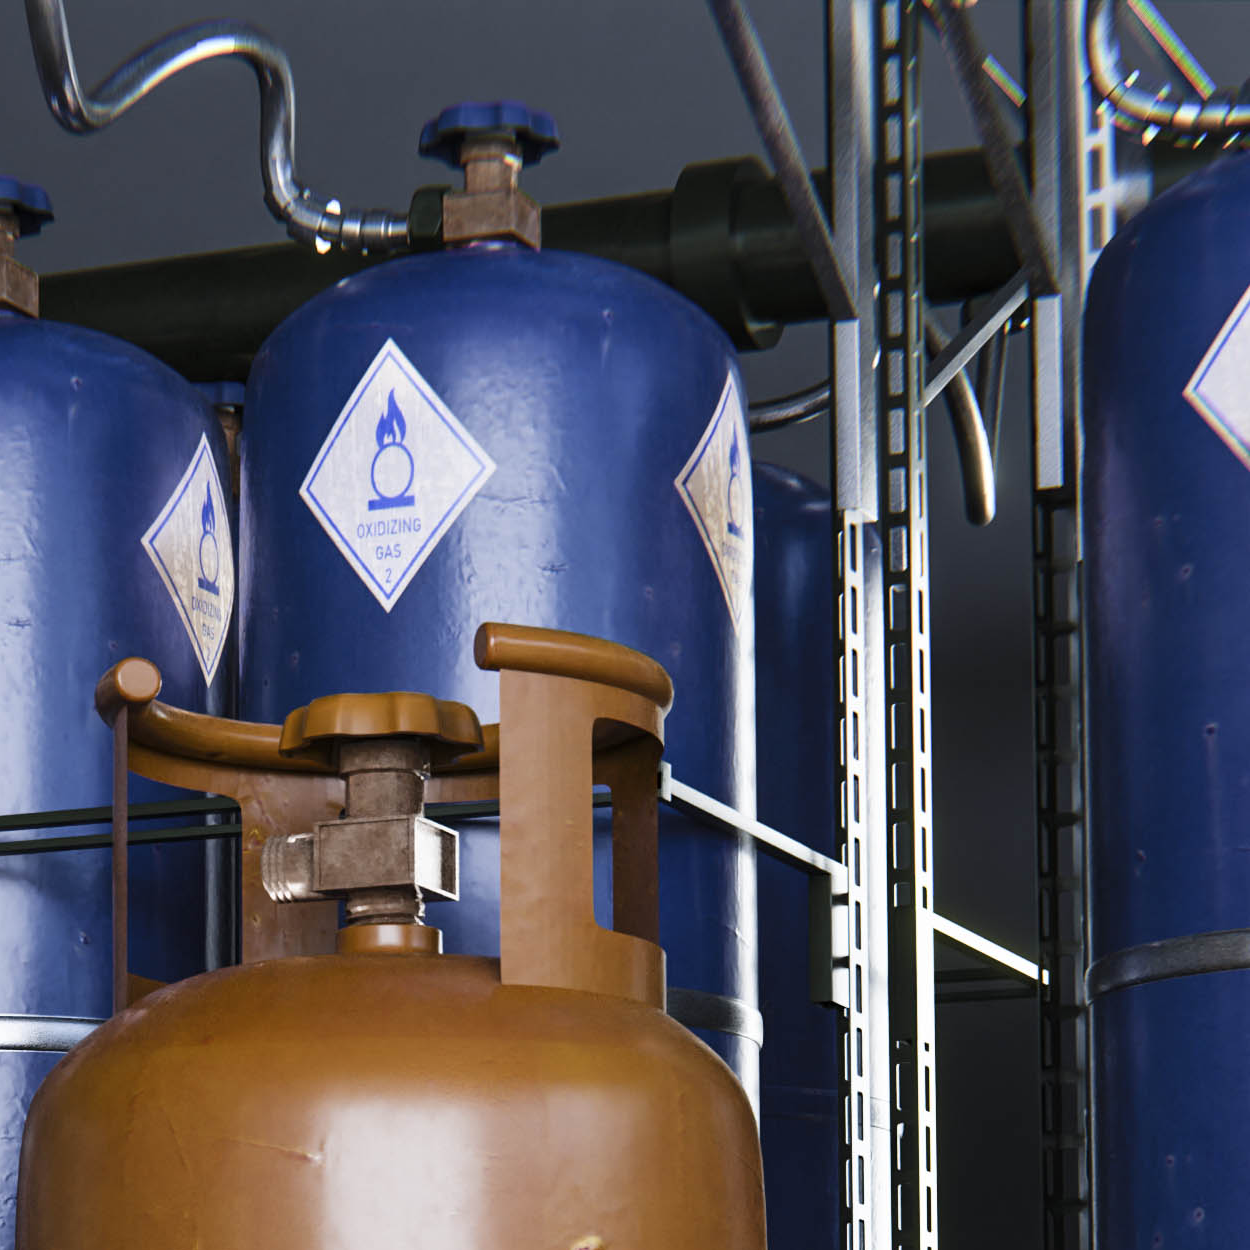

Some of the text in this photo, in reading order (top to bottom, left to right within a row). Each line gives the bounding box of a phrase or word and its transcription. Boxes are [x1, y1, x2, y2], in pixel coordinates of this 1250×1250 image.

[357, 517, 421, 539] OXIDIZING
[375, 544, 401, 560] GAS
[385, 567, 392, 583] 2
[202, 623, 215, 641] GAS
